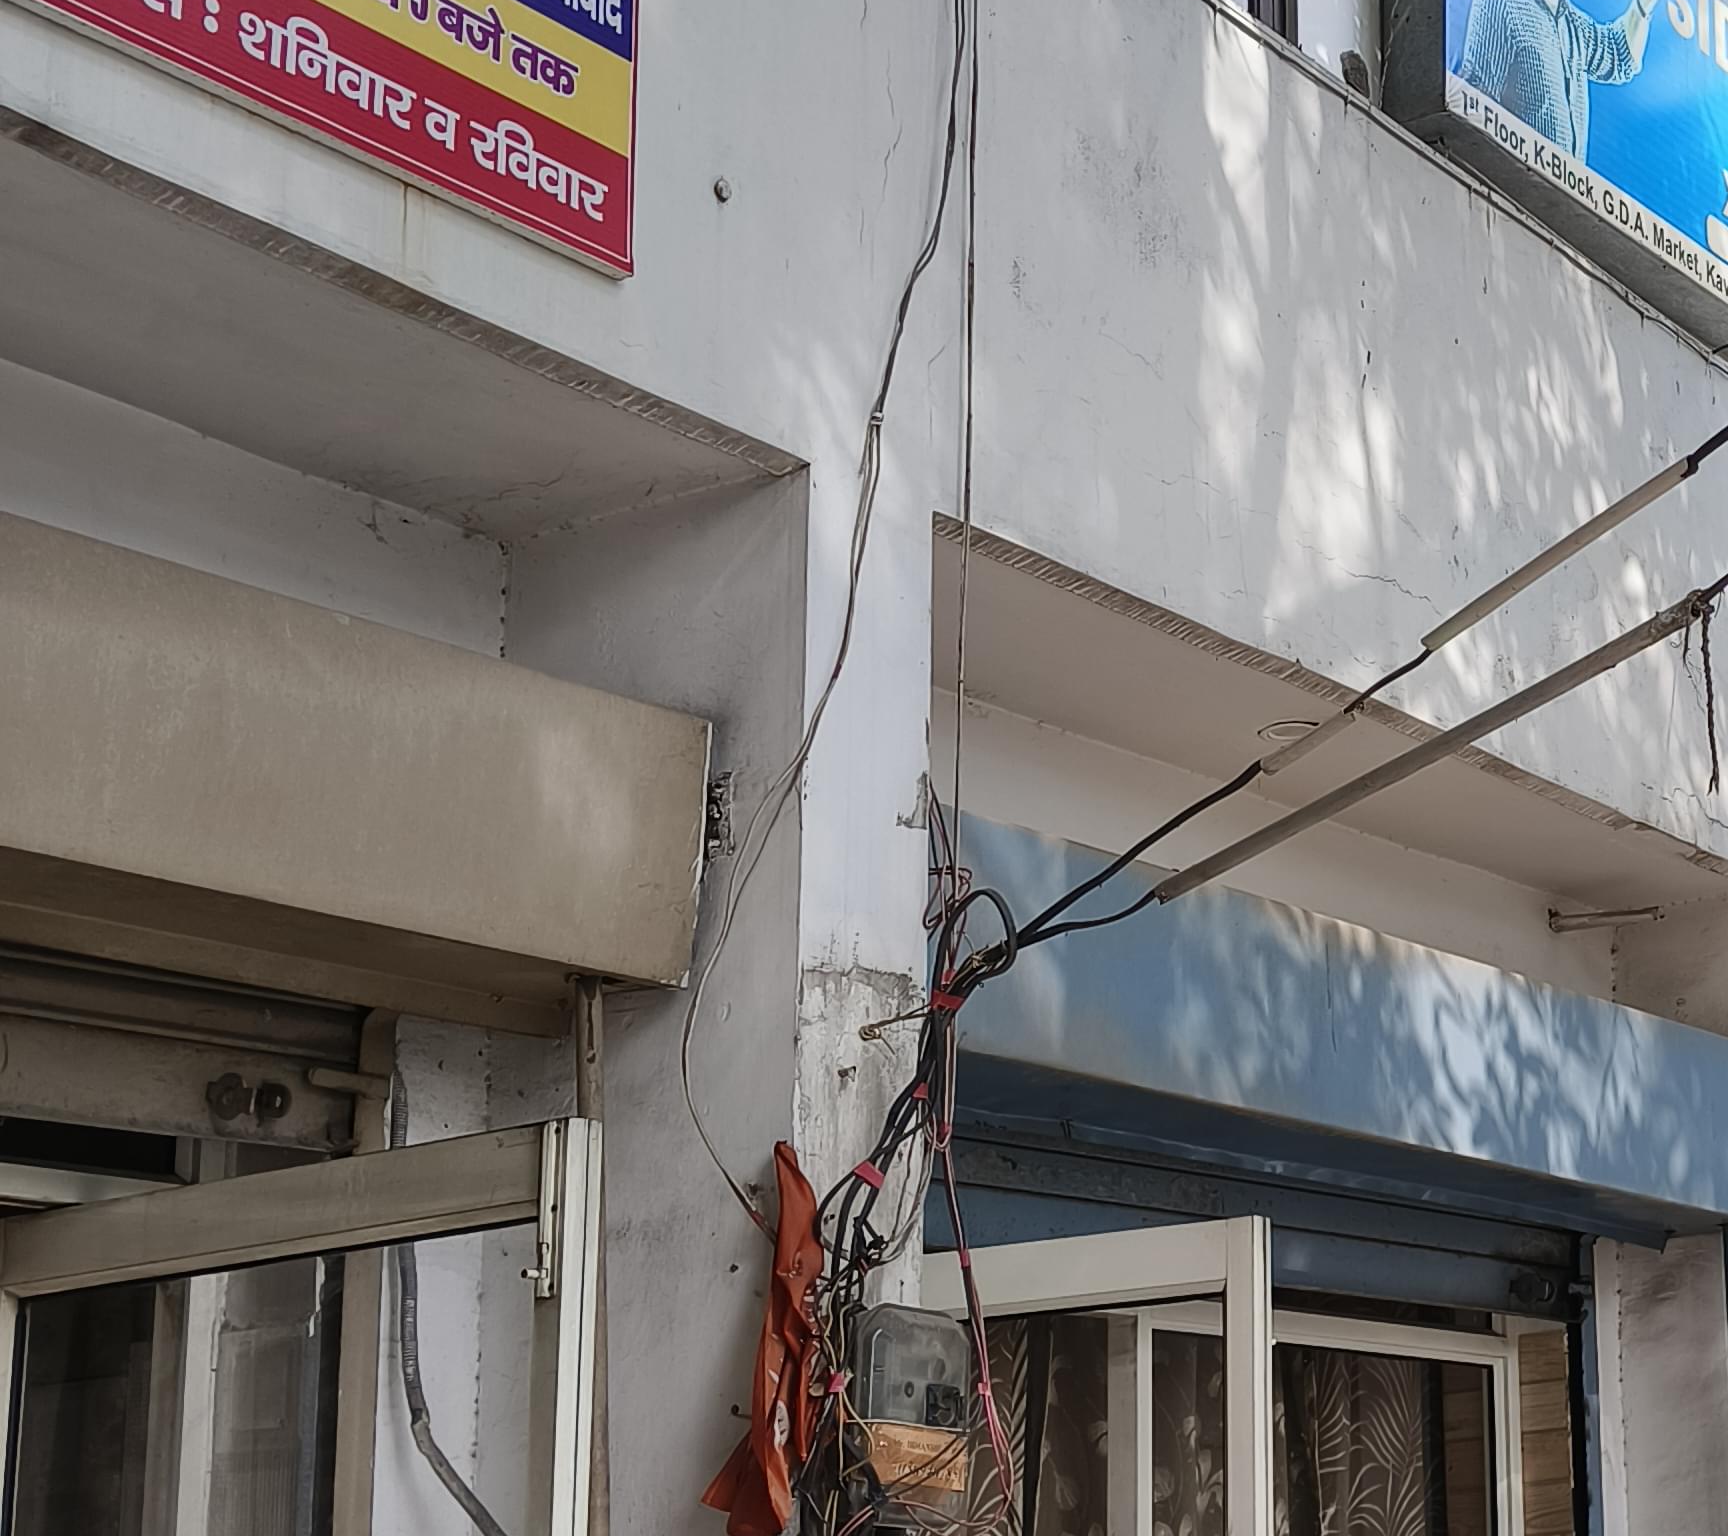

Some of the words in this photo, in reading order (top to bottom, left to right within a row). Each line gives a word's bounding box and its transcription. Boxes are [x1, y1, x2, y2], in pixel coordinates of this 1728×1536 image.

[239, 11, 416, 130] शनिवार
[425, 98, 460, 151] व
[470, 120, 607, 222] रविवार
[510, 33, 578, 95] तक
[1461, 90, 1479, 117] 1st
[1484, 104, 1528, 163] Floor,
[1534, 139, 1598, 210] K-Block,
[1603, 190, 1649, 240] G.D.A.
[1653, 222, 1703, 281] Market,
